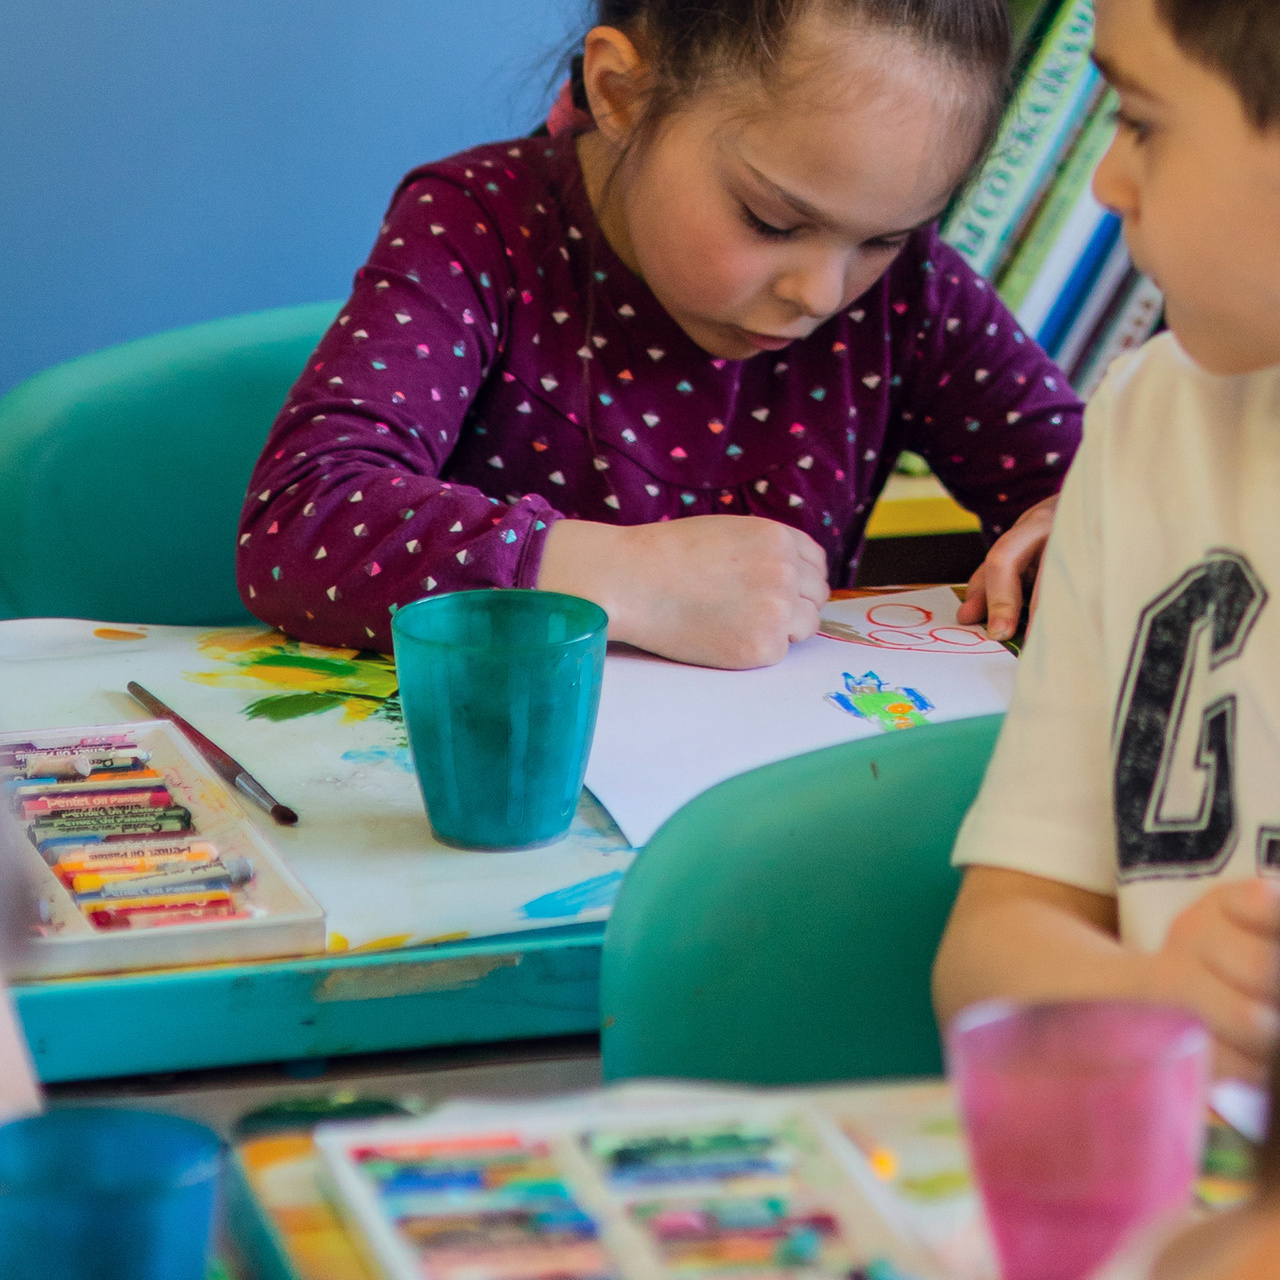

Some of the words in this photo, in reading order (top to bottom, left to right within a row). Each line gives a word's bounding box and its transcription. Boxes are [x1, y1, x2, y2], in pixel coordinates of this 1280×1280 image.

[38, 796, 90, 809] Pentel
[92, 796, 108, 805] Oil
[130, 850, 145, 858] Oil
[148, 846, 191, 857] Pentel
